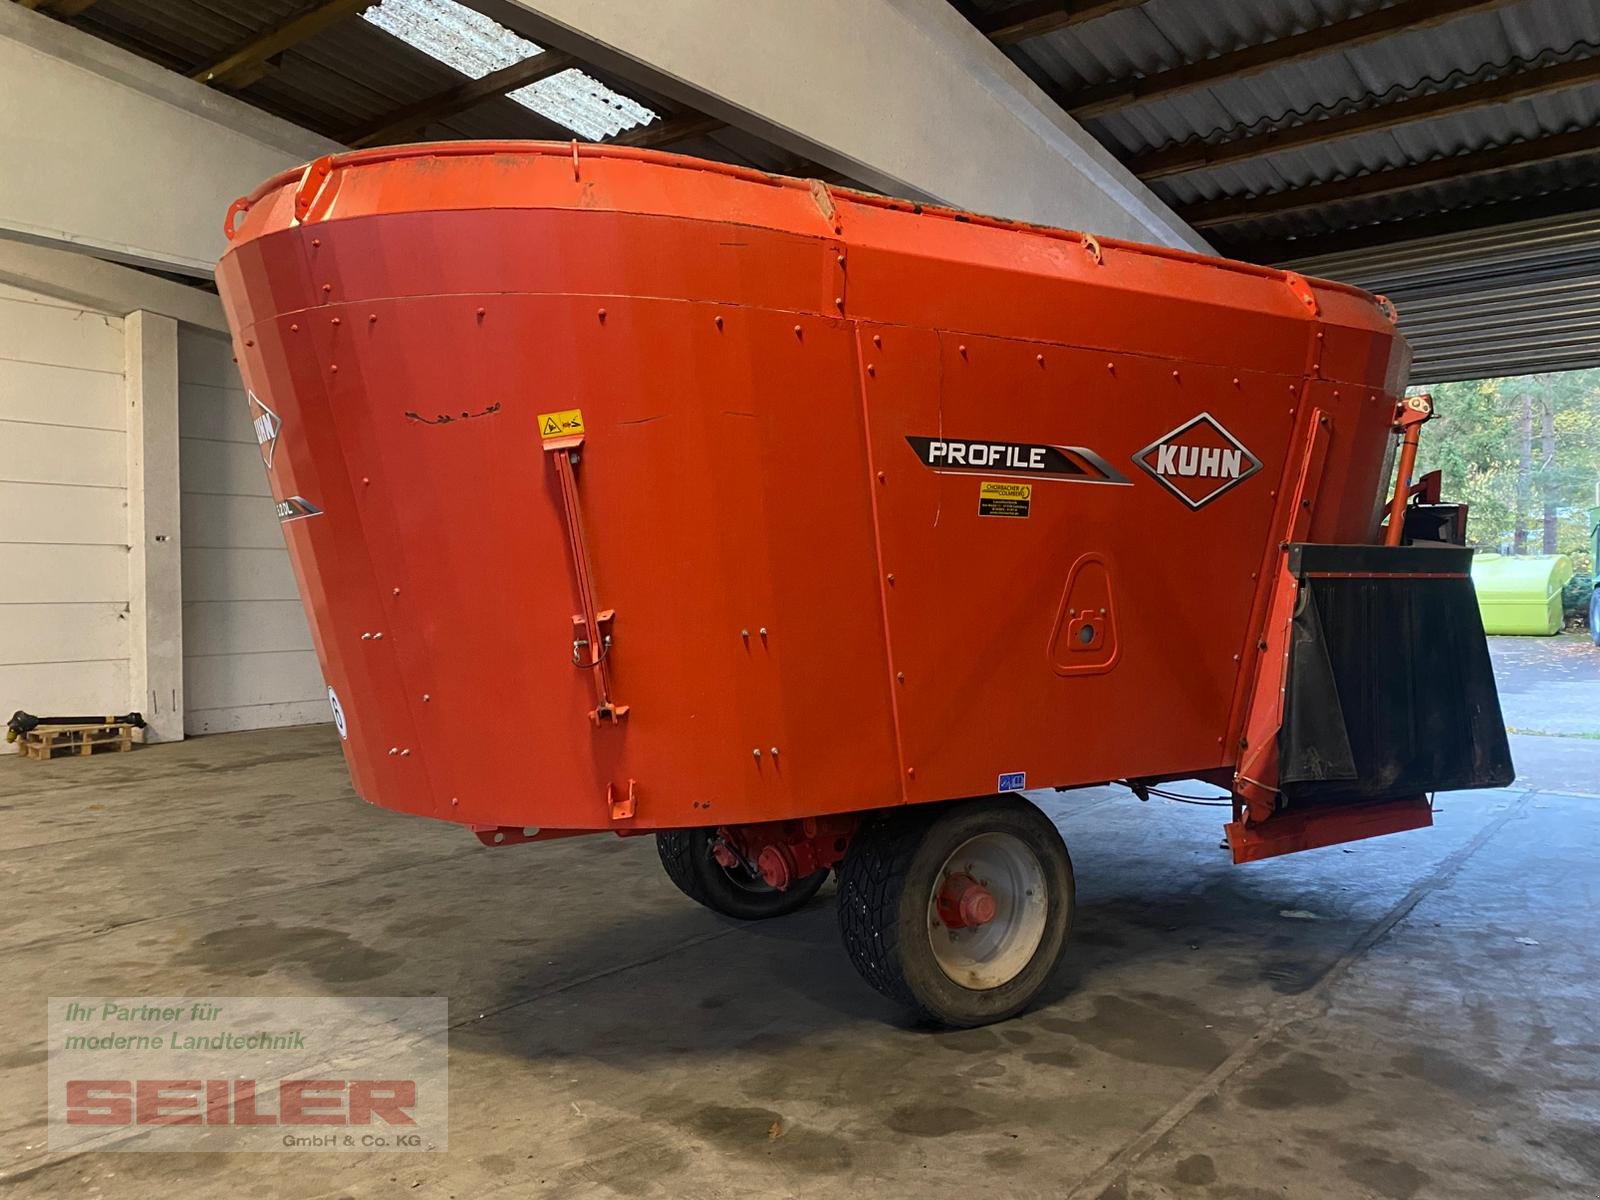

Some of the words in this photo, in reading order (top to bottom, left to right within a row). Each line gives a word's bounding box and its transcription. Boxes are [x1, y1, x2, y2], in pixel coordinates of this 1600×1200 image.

[253, 412, 276, 445] UHN
[928, 441, 1046, 469] PROFILE
[1156, 444, 1242, 478] KUHN
